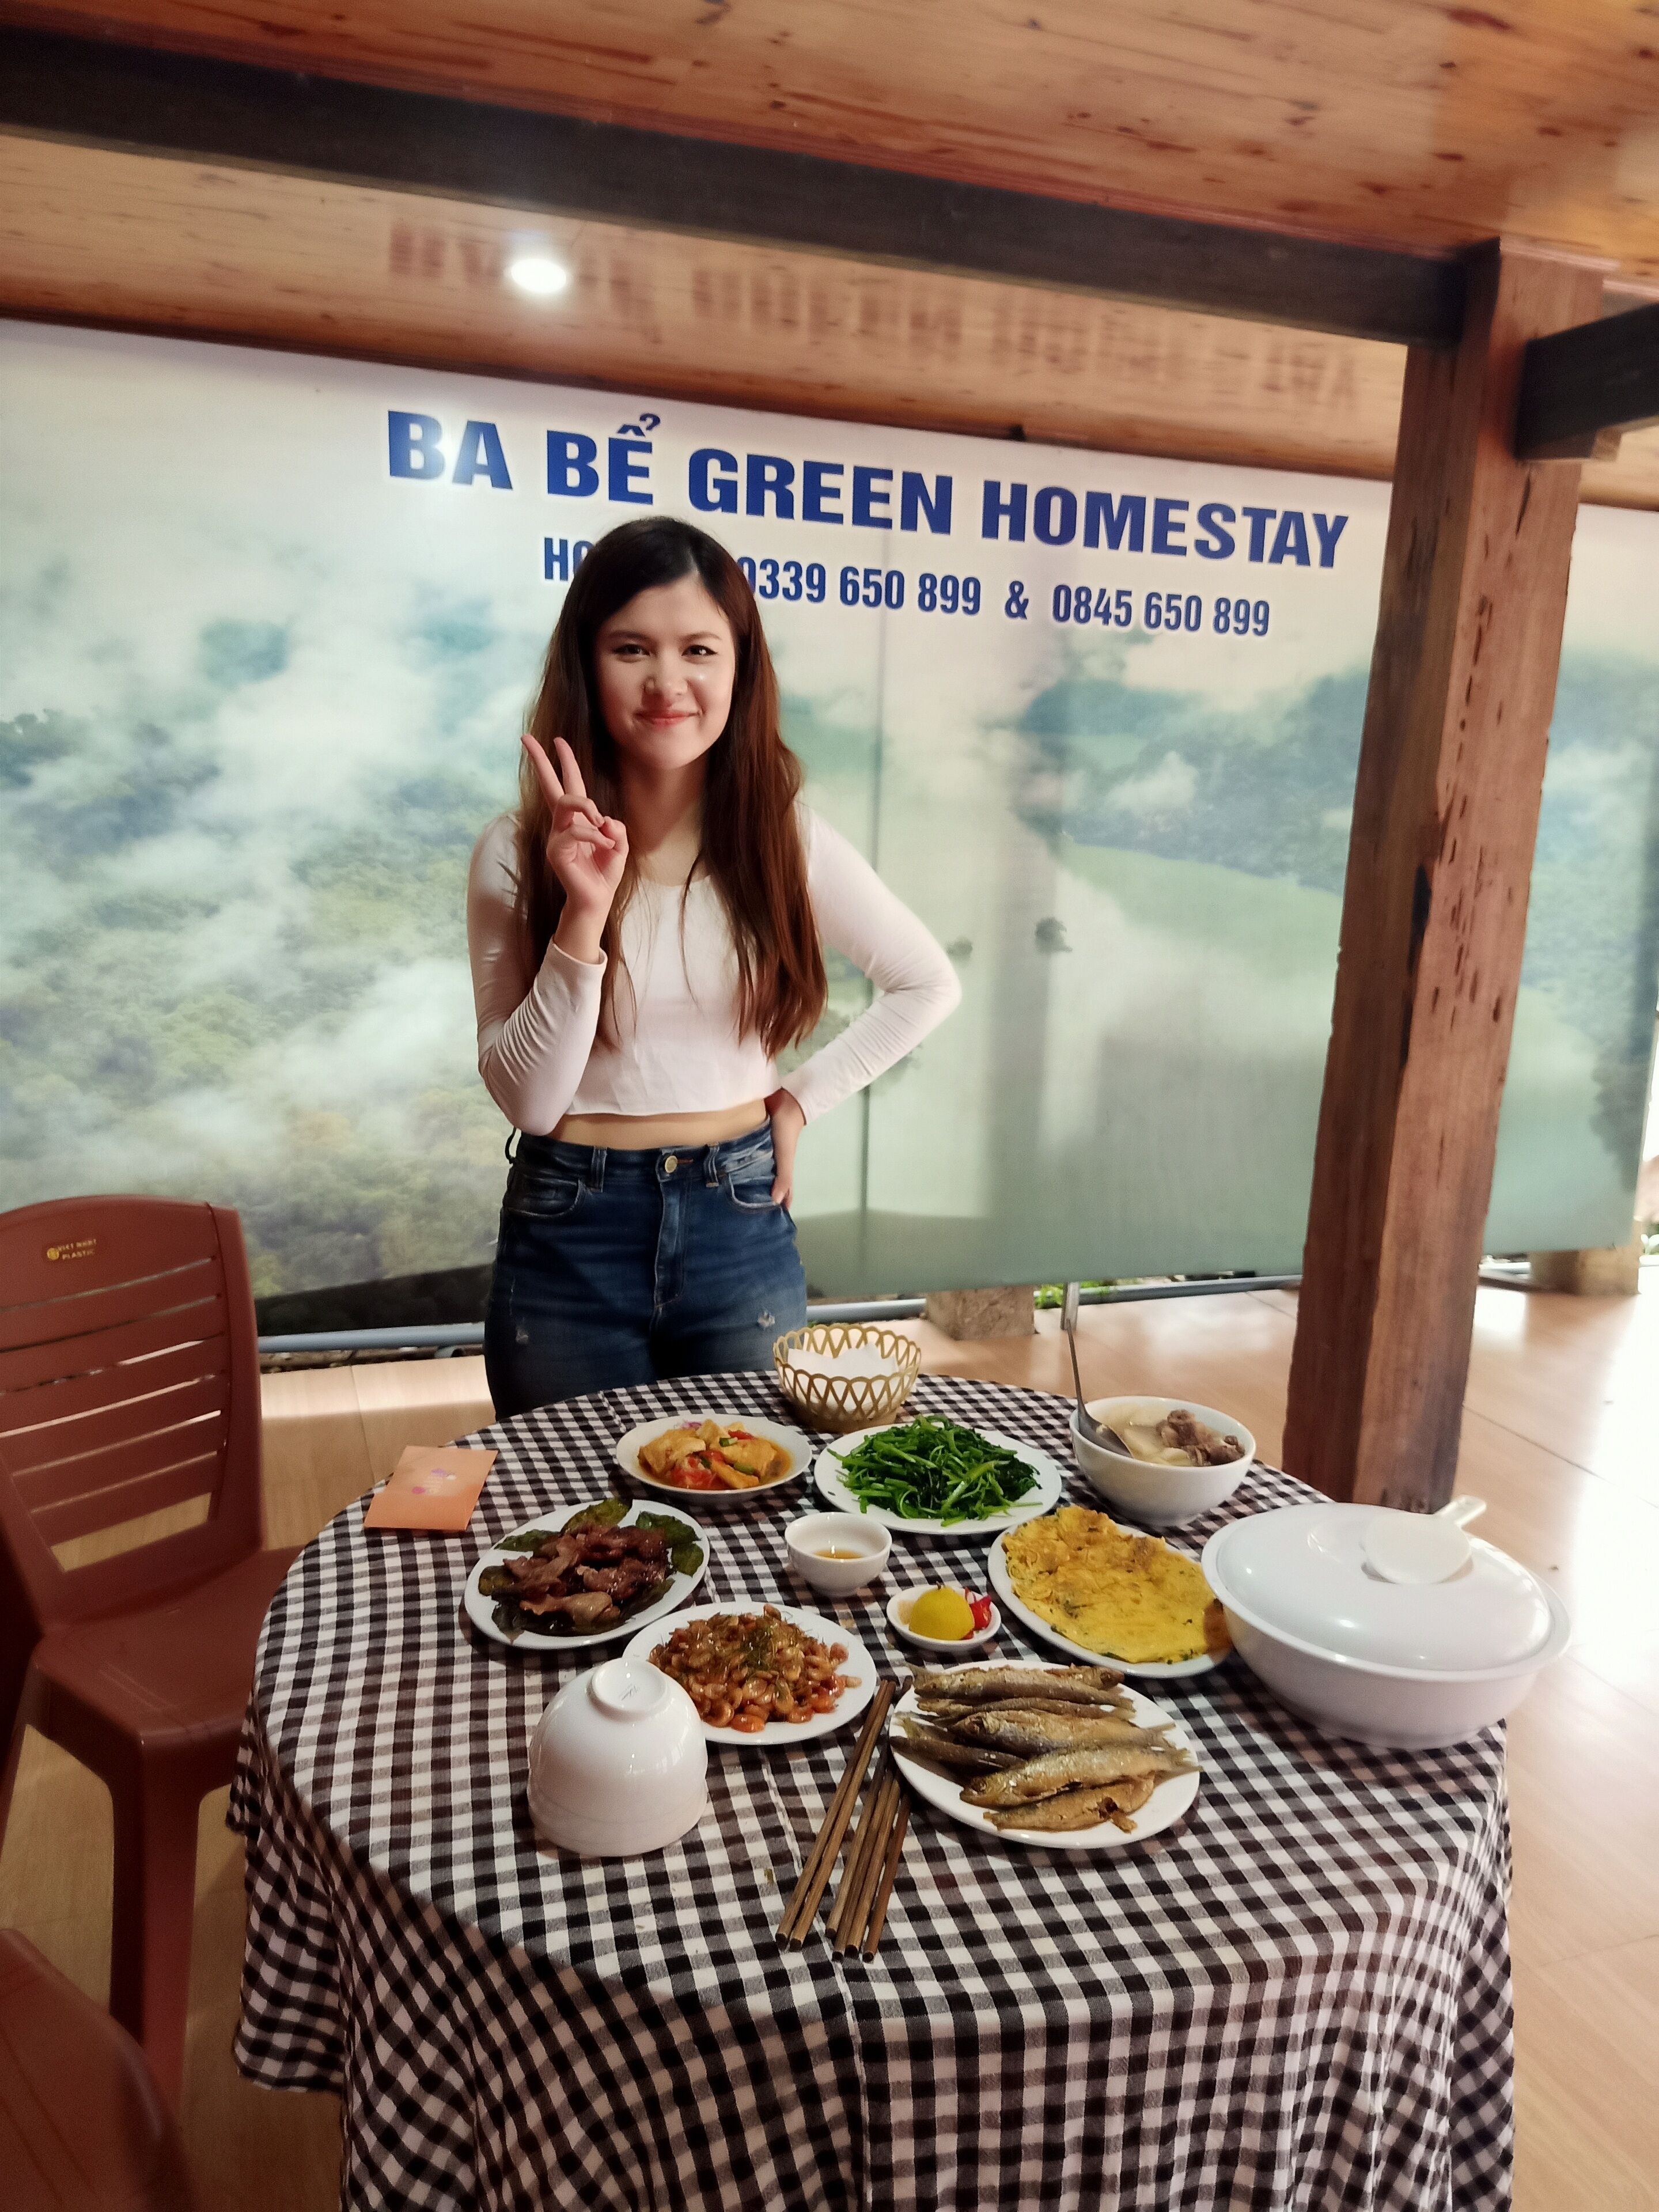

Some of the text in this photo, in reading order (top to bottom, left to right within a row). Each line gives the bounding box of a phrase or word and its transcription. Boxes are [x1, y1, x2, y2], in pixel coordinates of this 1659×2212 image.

[388, 410, 1349, 569] BA BỂ GREEN HOMESTAY
[840, 566, 904, 609] 650
[918, 573, 981, 615] 899
[1005, 581, 1029, 620] &
[1053, 585, 1132, 627] 0845
[1145, 592, 1202, 633] 650
[1214, 598, 1270, 637] 899
